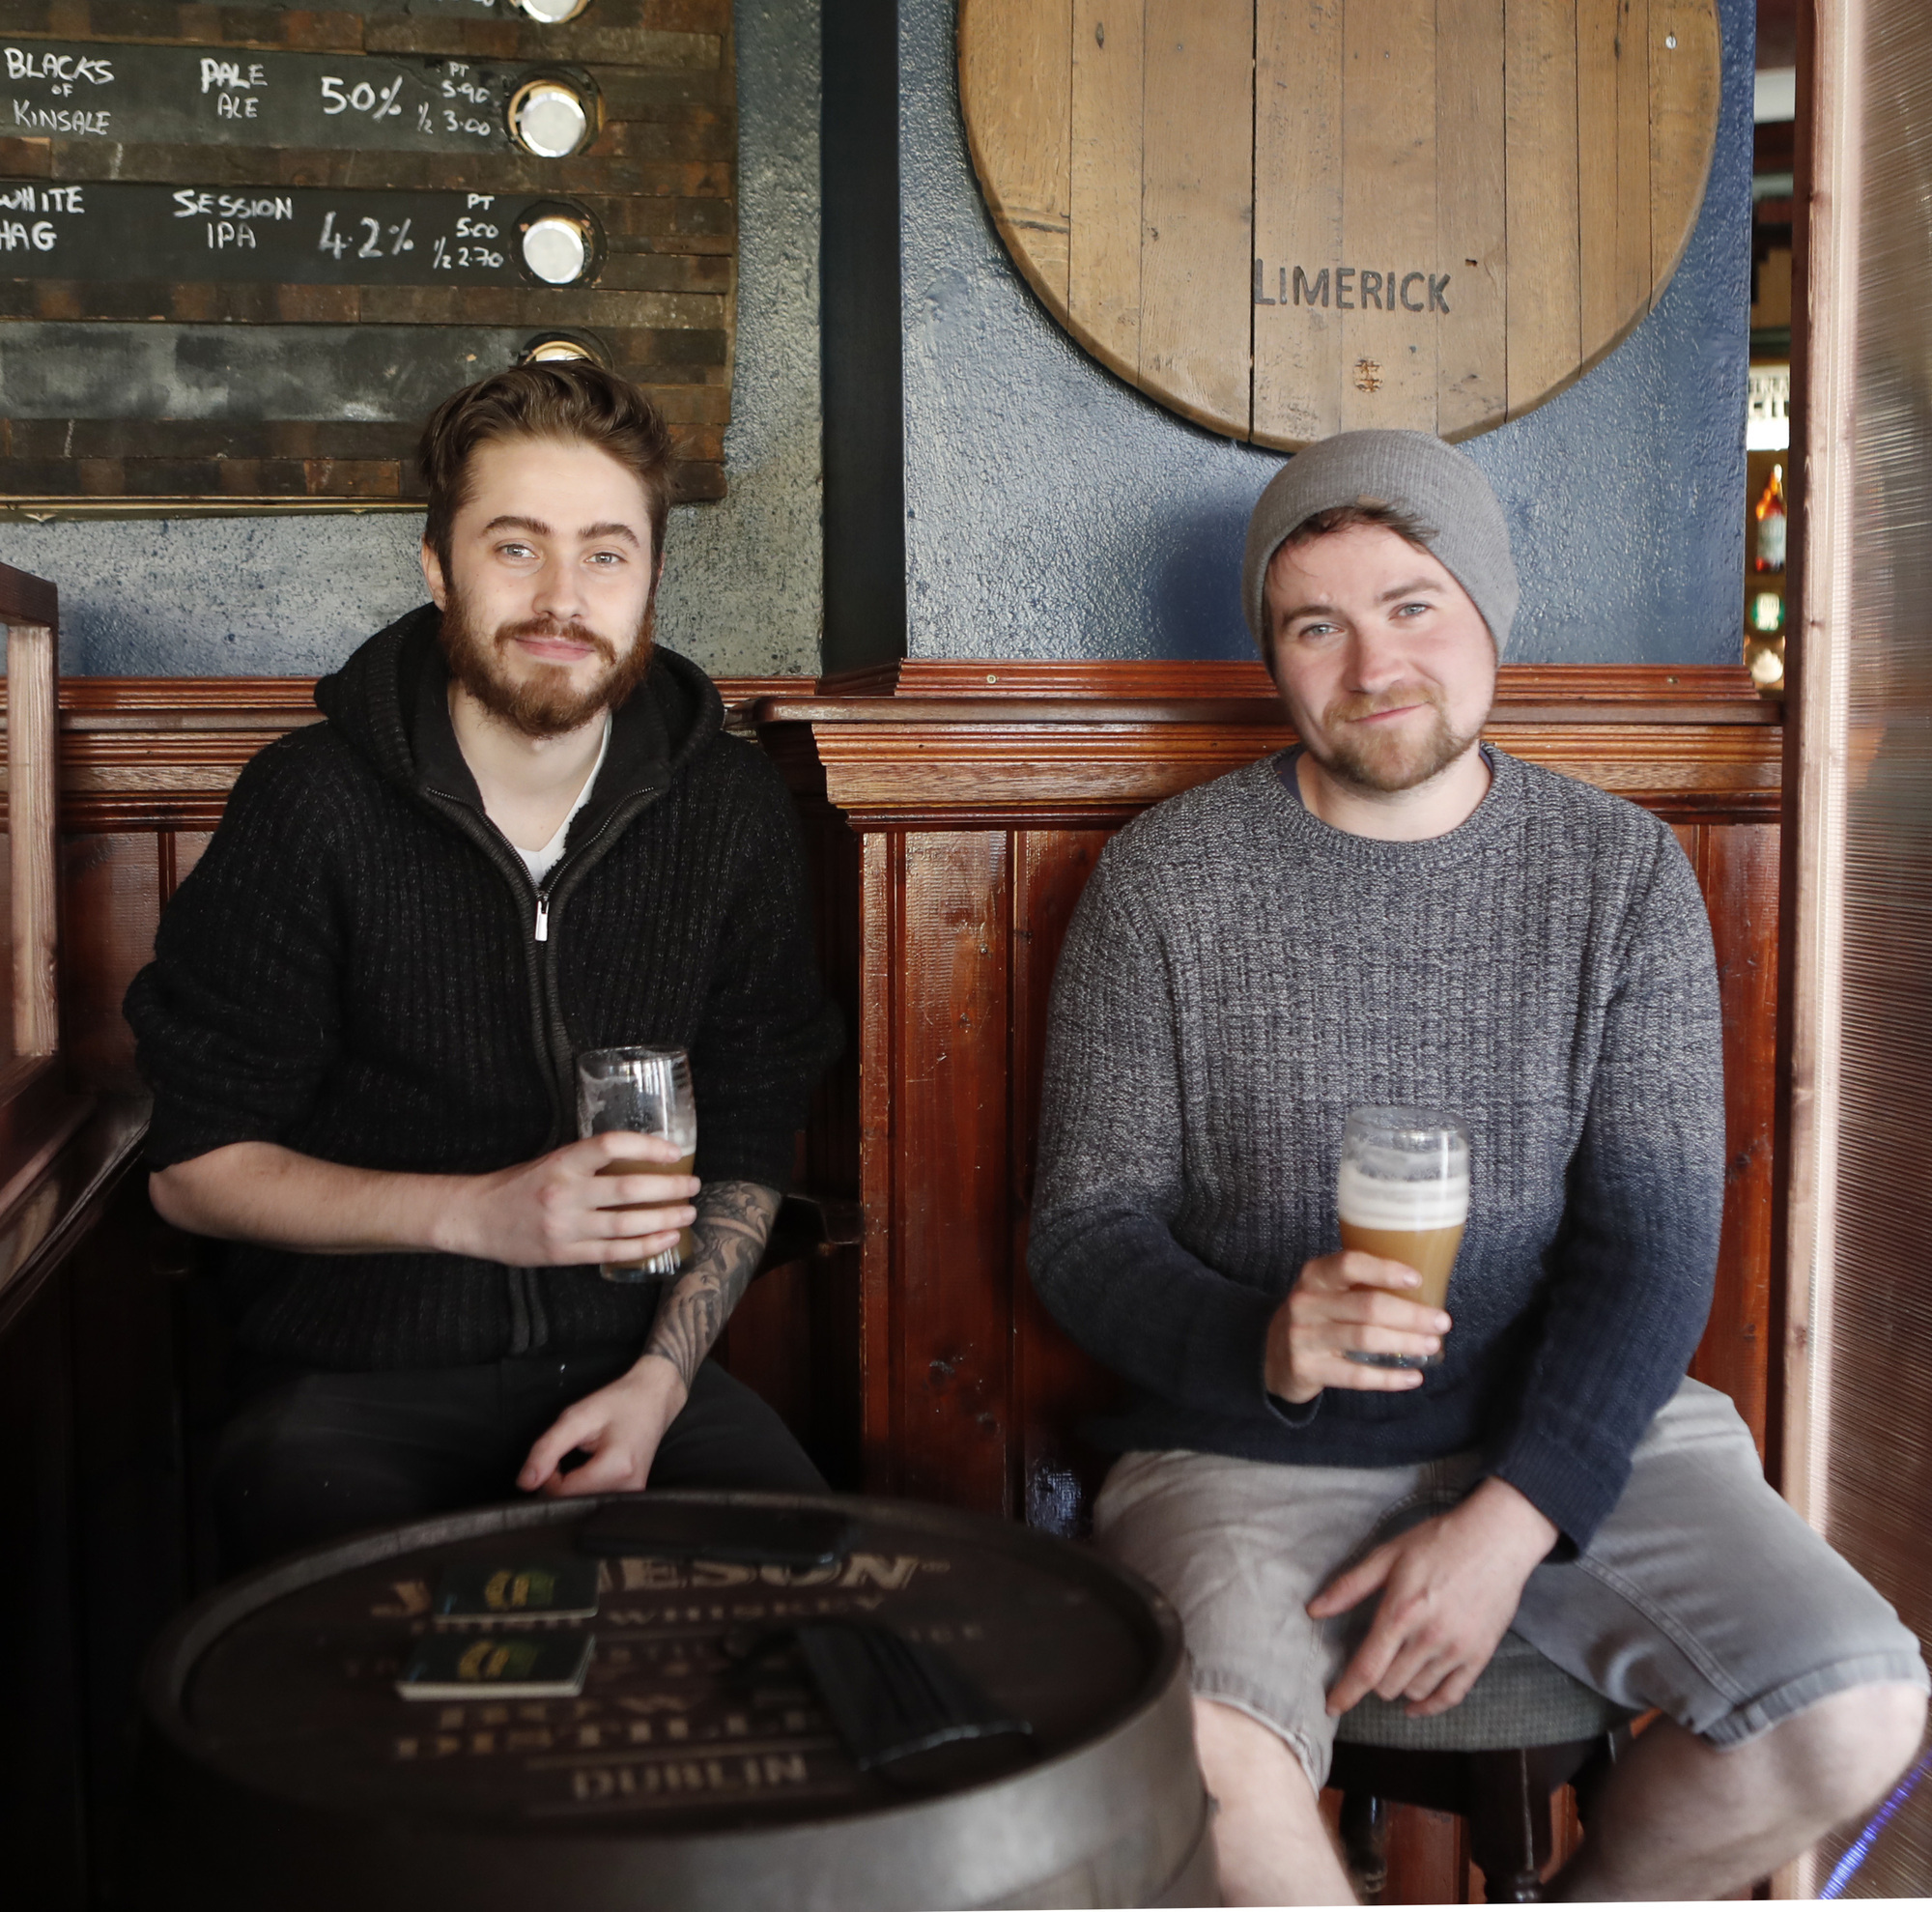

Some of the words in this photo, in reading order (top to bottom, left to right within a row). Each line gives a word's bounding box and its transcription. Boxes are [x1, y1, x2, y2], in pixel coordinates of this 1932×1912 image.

[4, 47, 115, 84] BLACKS
[200, 57, 268, 93] PALE
[449, 61, 469, 77] PT
[51, 83, 73, 97] OF
[13, 99, 111, 135] KINSALE
[217, 92, 259, 119] ALE
[442, 109, 491, 136] 3.00
[173, 189, 293, 220] SESSION
[467, 193, 495, 211] PT
[0, 219, 57, 251] HAG
[208, 222, 257, 249] IPA
[318, 211, 415, 261] 4.2%
[458, 246, 504, 269] 2.70
[1255, 258, 1452, 315] LIMERICK
